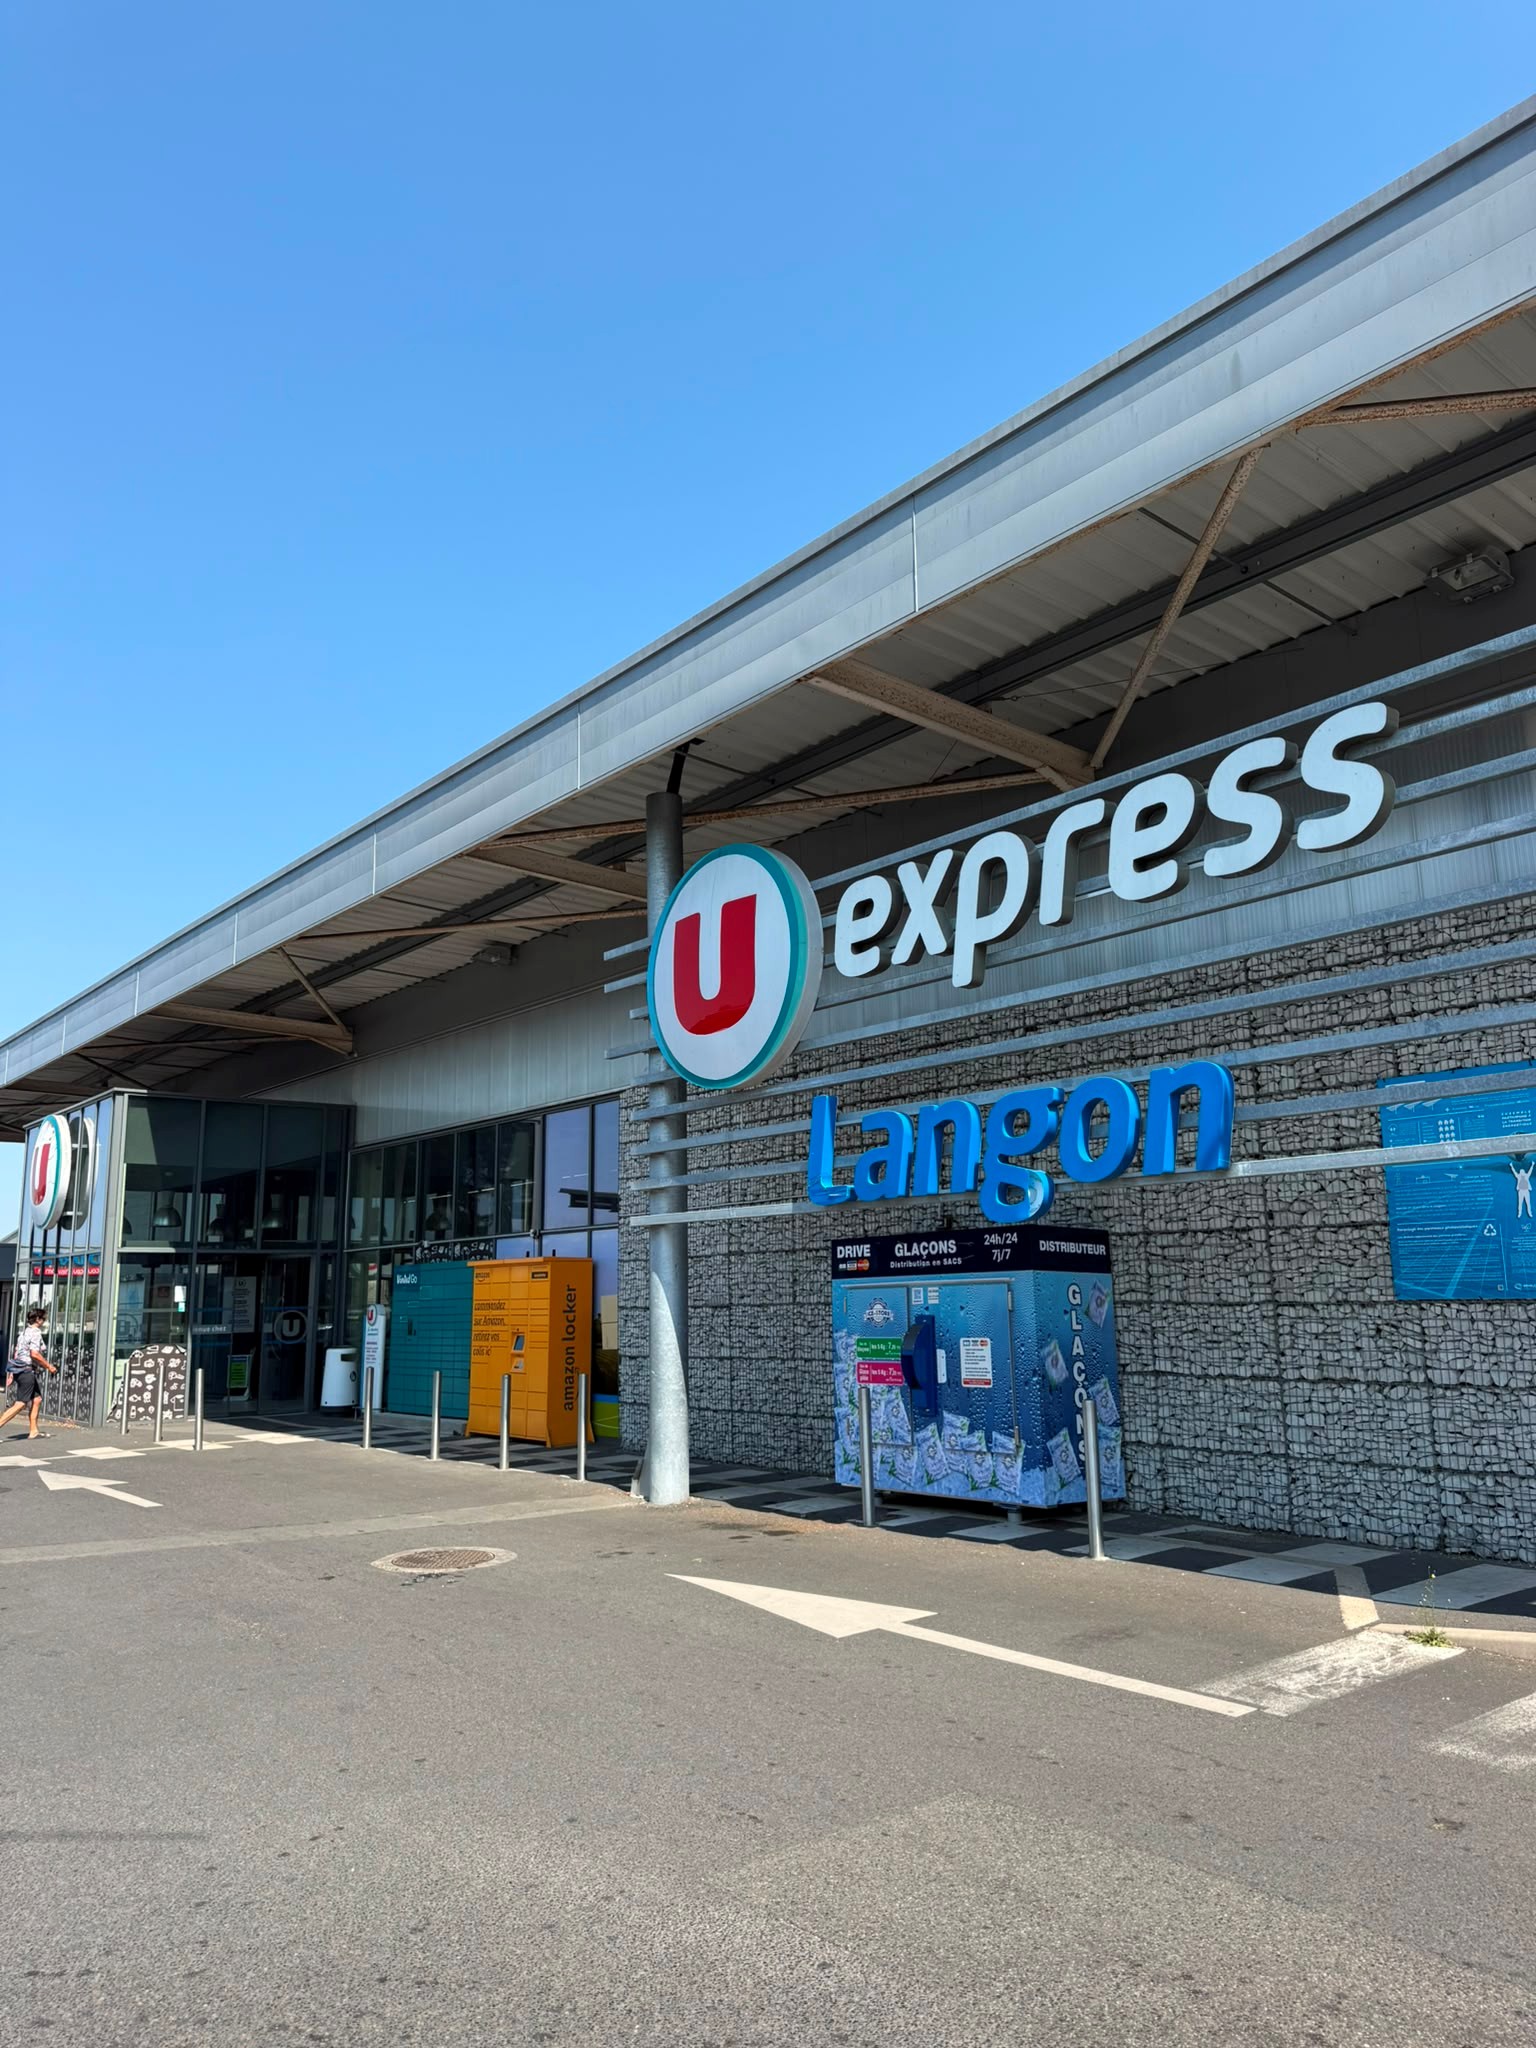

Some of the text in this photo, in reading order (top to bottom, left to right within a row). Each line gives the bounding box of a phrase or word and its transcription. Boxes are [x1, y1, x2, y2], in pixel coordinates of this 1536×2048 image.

[672, 702, 1392, 1035] U express
[807, 1060, 1236, 1223] Langon
[32, 1143, 51, 1206] U
[983, 1232, 1018, 1246] 24h/24
[836, 1244, 871, 1259] DRIVE
[894, 1239, 957, 1259] GLAÇONS
[991, 1248, 1011, 1263] 7j/7
[1039, 1240, 1107, 1256] DISTRIBUTEUR
[890, 1259, 930, 1269] Distribution
[943, 1257, 962, 1267] SACS
[282, 1320, 300, 1336] U
[561, 1284, 577, 1412] amazon locker
